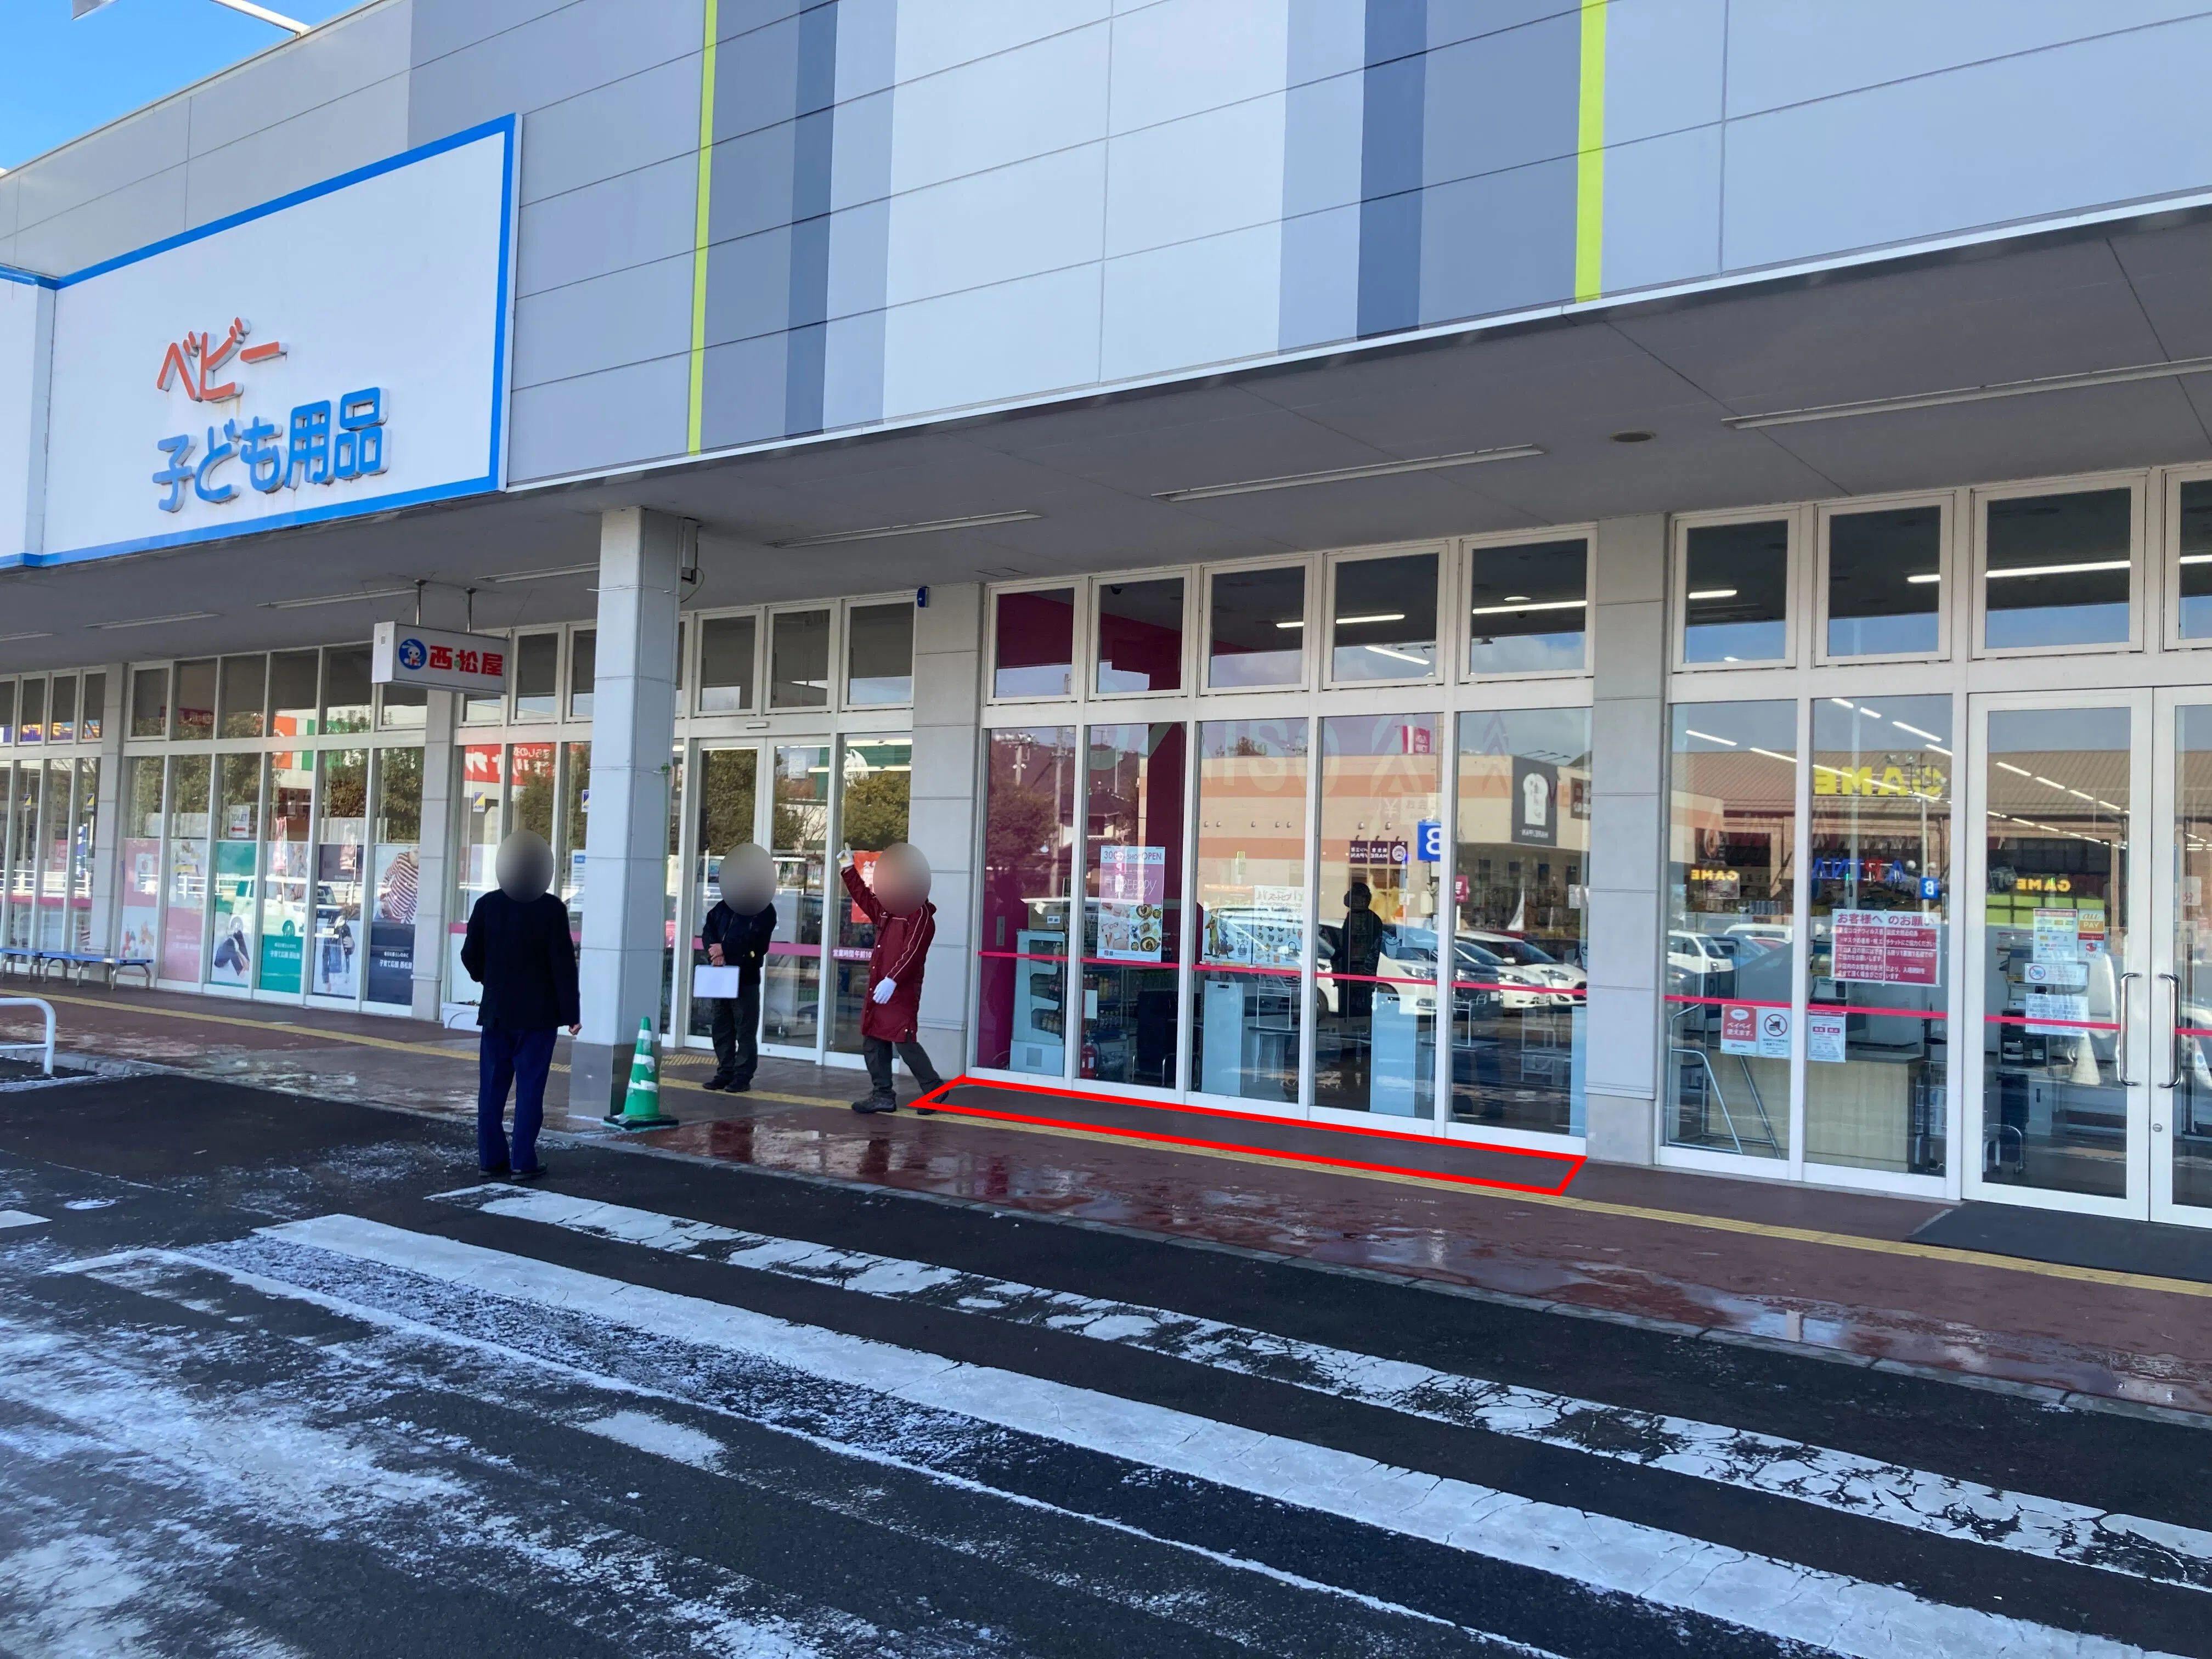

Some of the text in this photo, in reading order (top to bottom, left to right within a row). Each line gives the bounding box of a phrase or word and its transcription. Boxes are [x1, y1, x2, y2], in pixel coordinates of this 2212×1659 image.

[157, 317, 287, 402] ベビー
[153, 387, 389, 512] 子ども用品
[429, 645, 503, 676] 西松屋
[1142, 852, 1162, 861] OPEN
[1837, 912, 1883, 924] お客様へ
